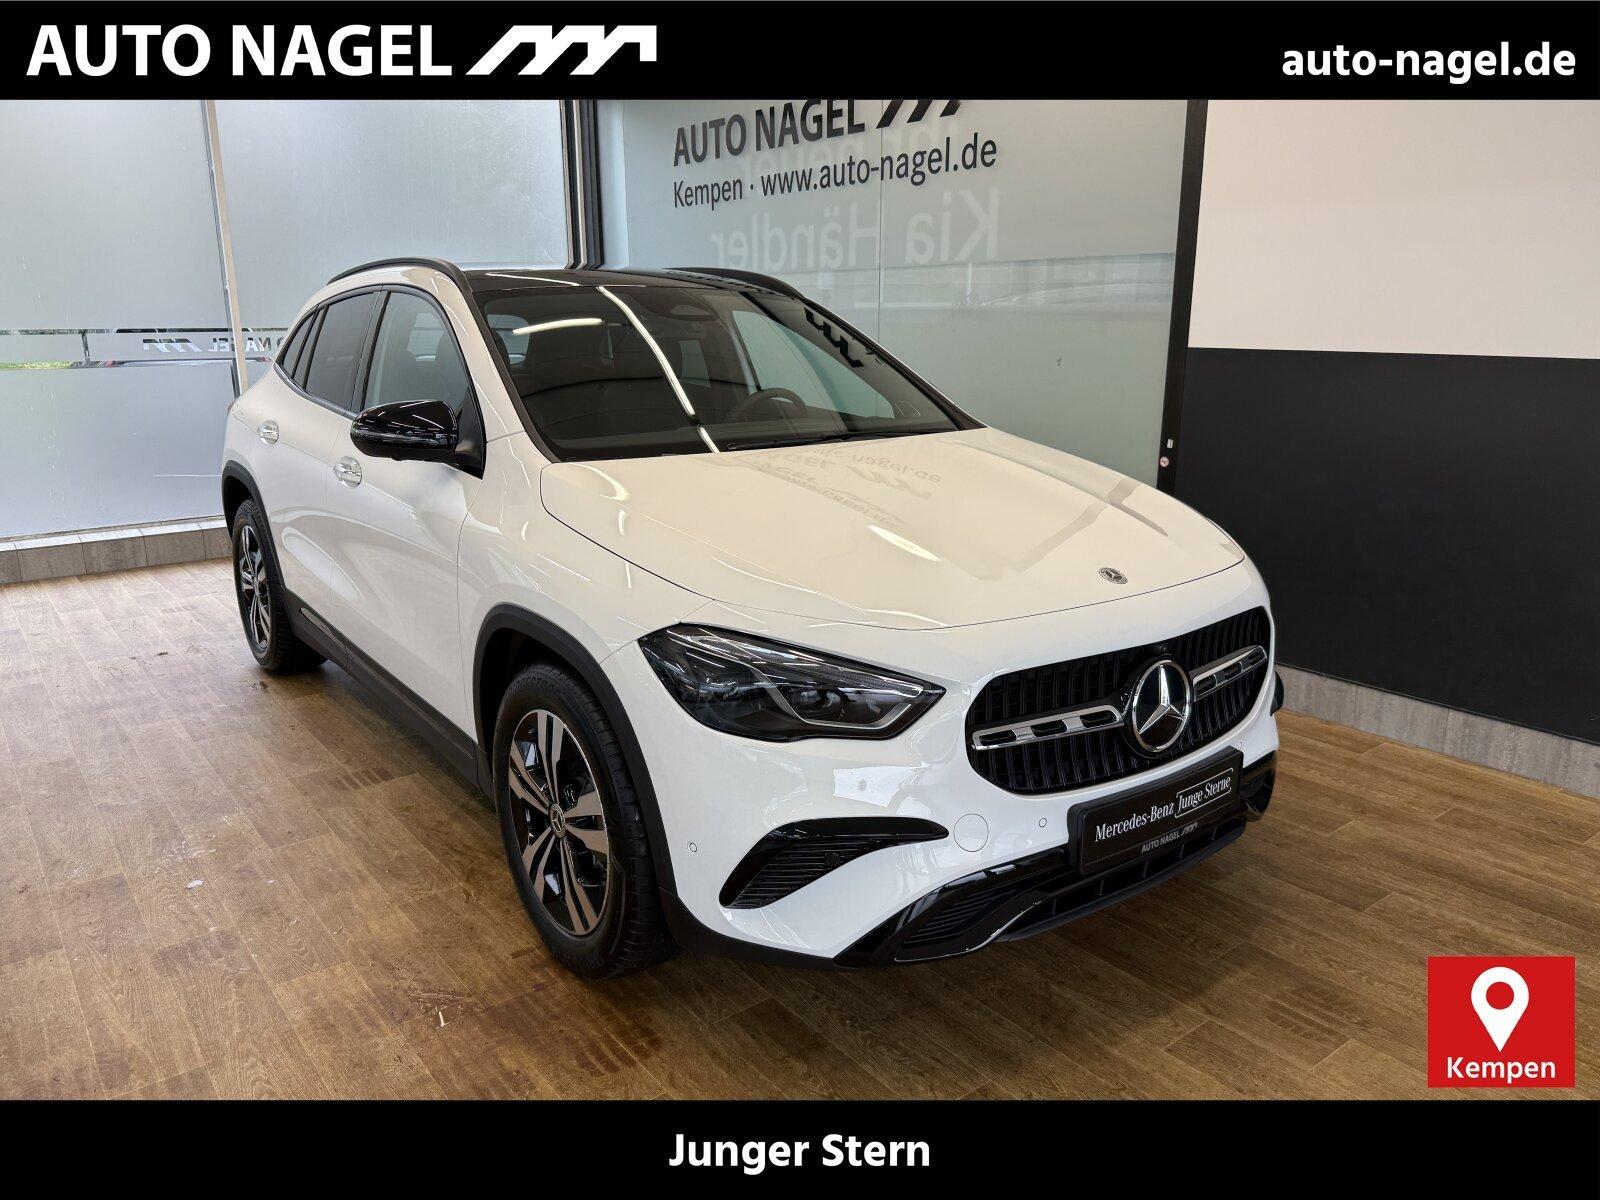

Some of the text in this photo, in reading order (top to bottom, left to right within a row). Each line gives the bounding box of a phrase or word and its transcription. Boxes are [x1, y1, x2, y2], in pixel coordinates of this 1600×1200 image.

[673, 99, 866, 167] AUTO NAGEL
[673, 132, 997, 212] Kempen www.auto-nagel.de
[1094, 776, 1232, 843] Mercedes-Benz Junge Sterne
[1141, 830, 1182, 854] AUTO NAGEL
